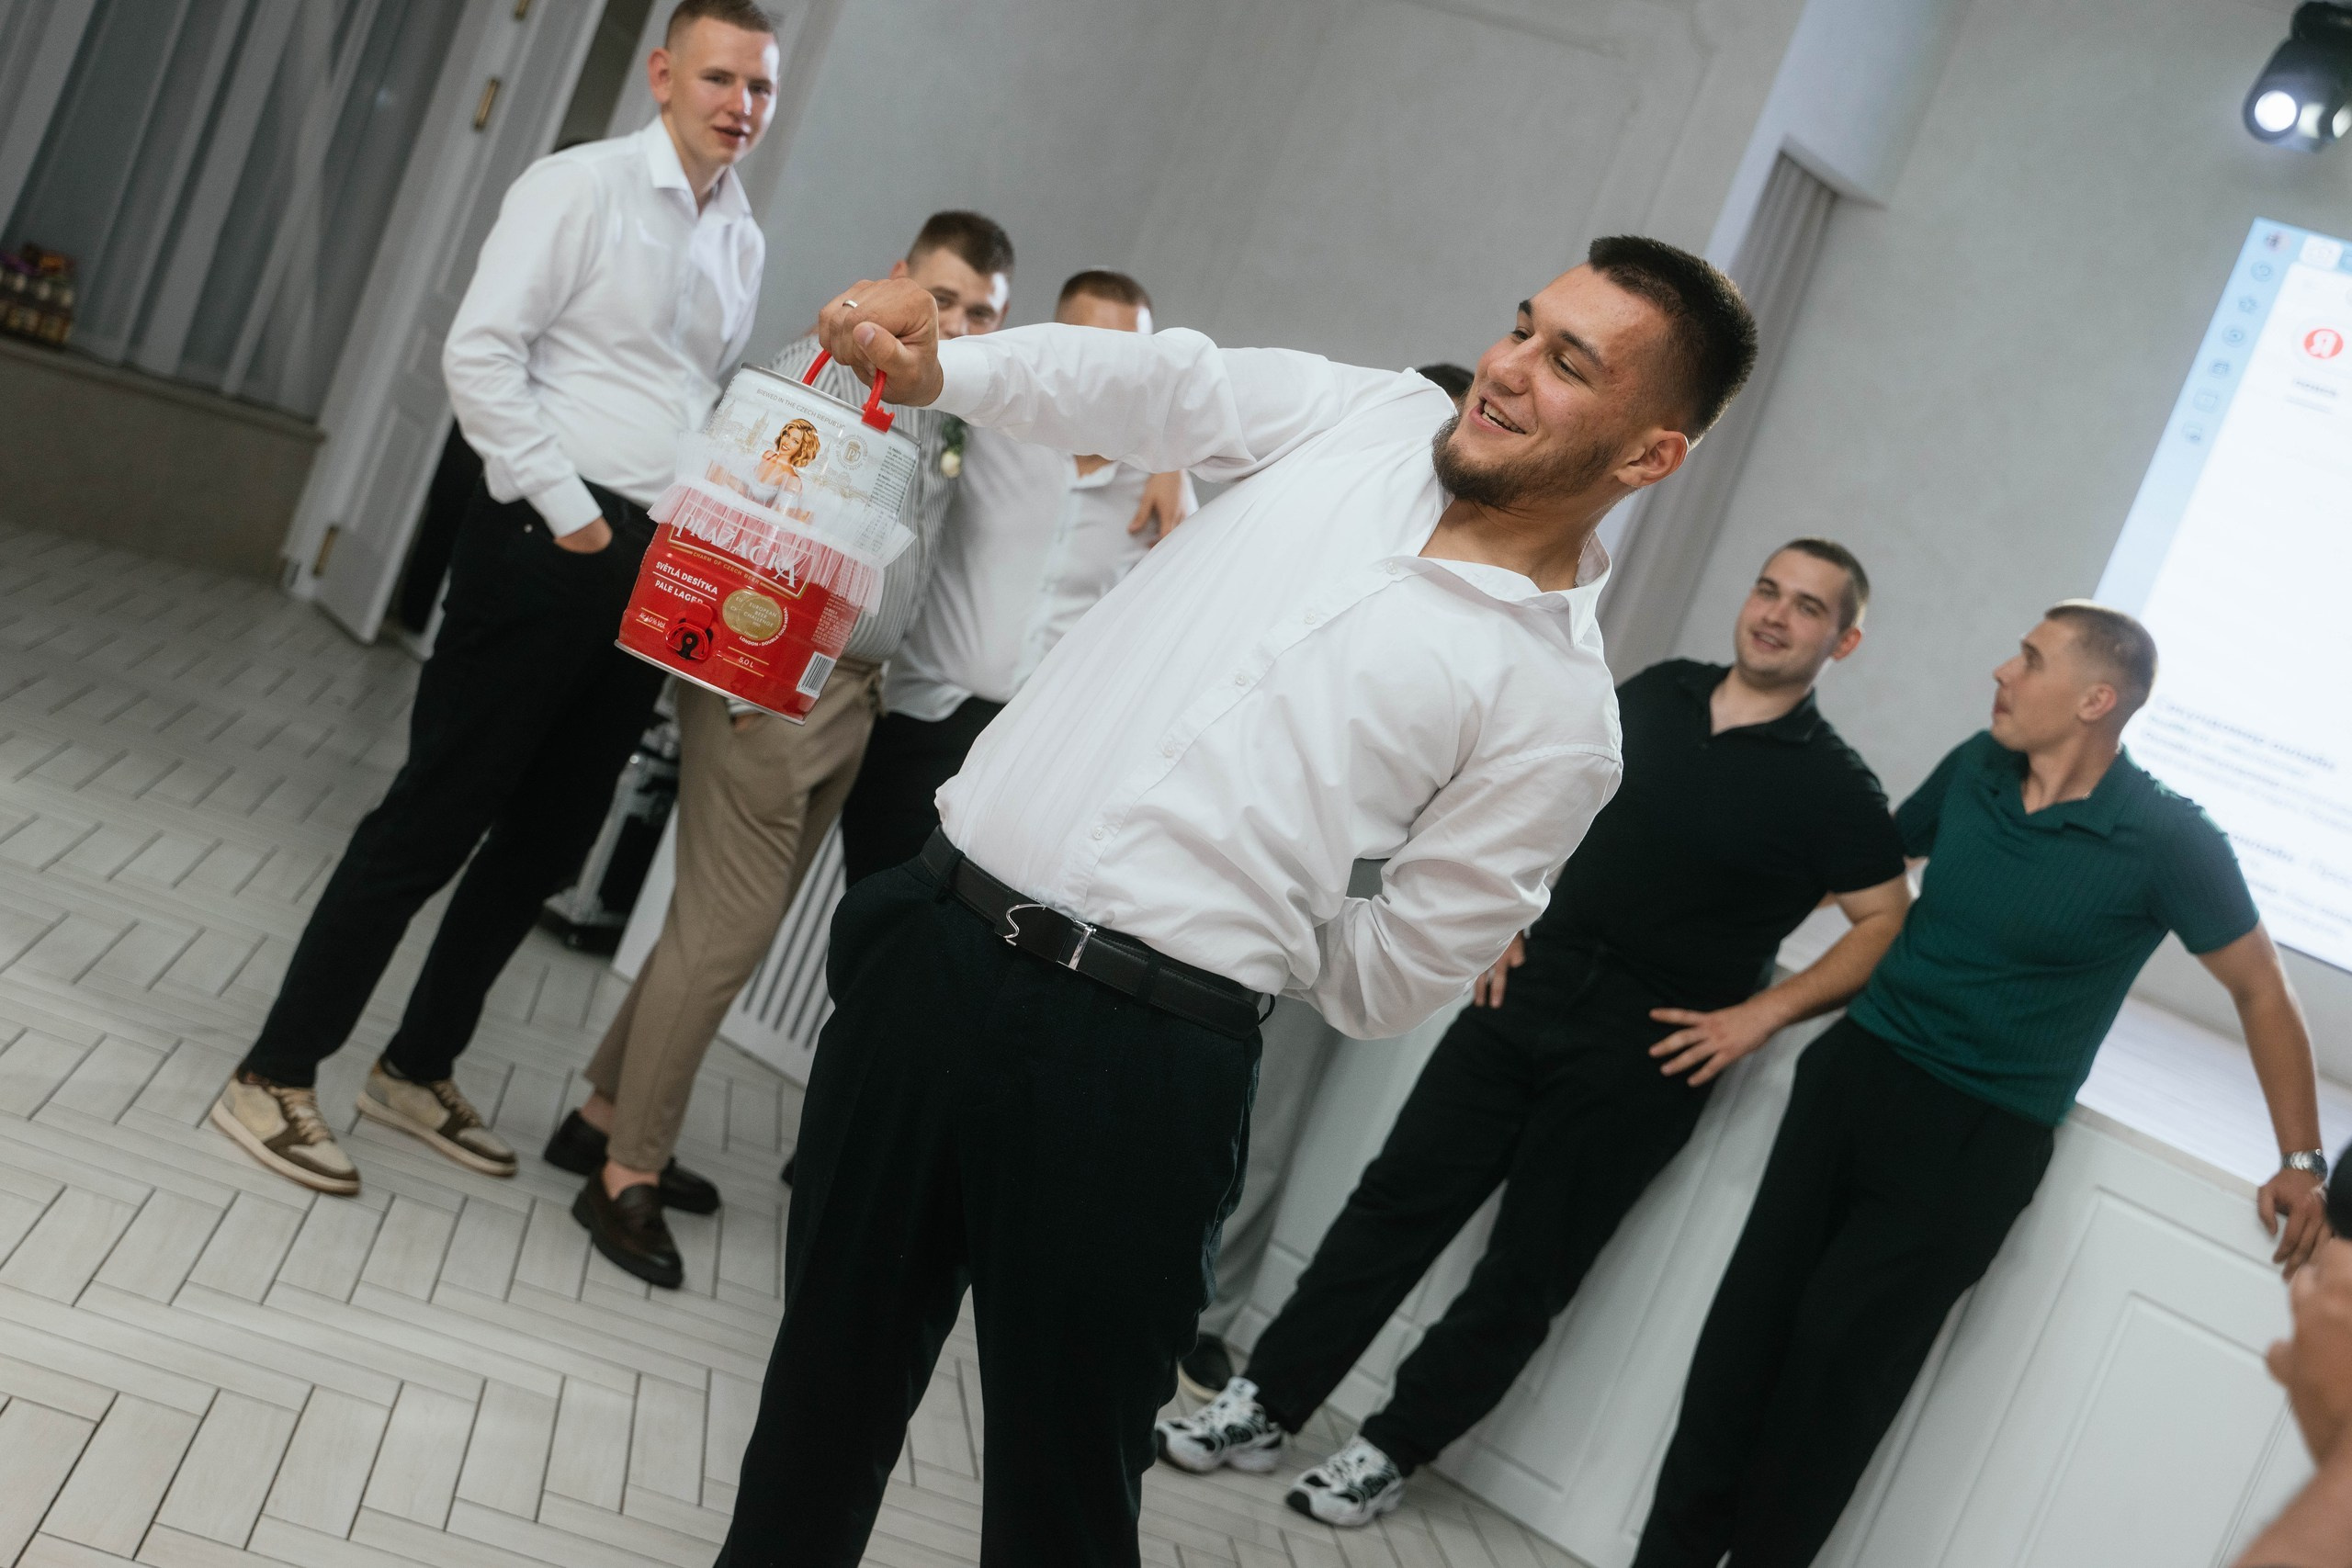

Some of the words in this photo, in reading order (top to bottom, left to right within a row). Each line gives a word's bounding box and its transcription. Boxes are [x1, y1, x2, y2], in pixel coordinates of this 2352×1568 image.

[756, 388, 778, 401] BREWED
[785, 400, 796, 409] THE
[796, 405, 817, 418] CZECH
[817, 413, 845, 430] REPUBLIC
[693, 551, 713, 563] CHARM
[723, 563, 742, 576] CZECH
[743, 573, 761, 585] BEER
[655, 560, 682, 579] SVĚTLÁ
[681, 572, 718, 595] DESÍTKA
[655, 580, 673, 593] PALE
[749, 602, 778, 618] EUROPEAN
[754, 610, 769, 620] BEER
[743, 611, 775, 628] CHALLENGE
[739, 635, 759, 647] LONDON
[761, 634, 780, 647] DOUBLE
[778, 624, 787, 637] GOLD
[738, 656, 750, 666] 5,0
